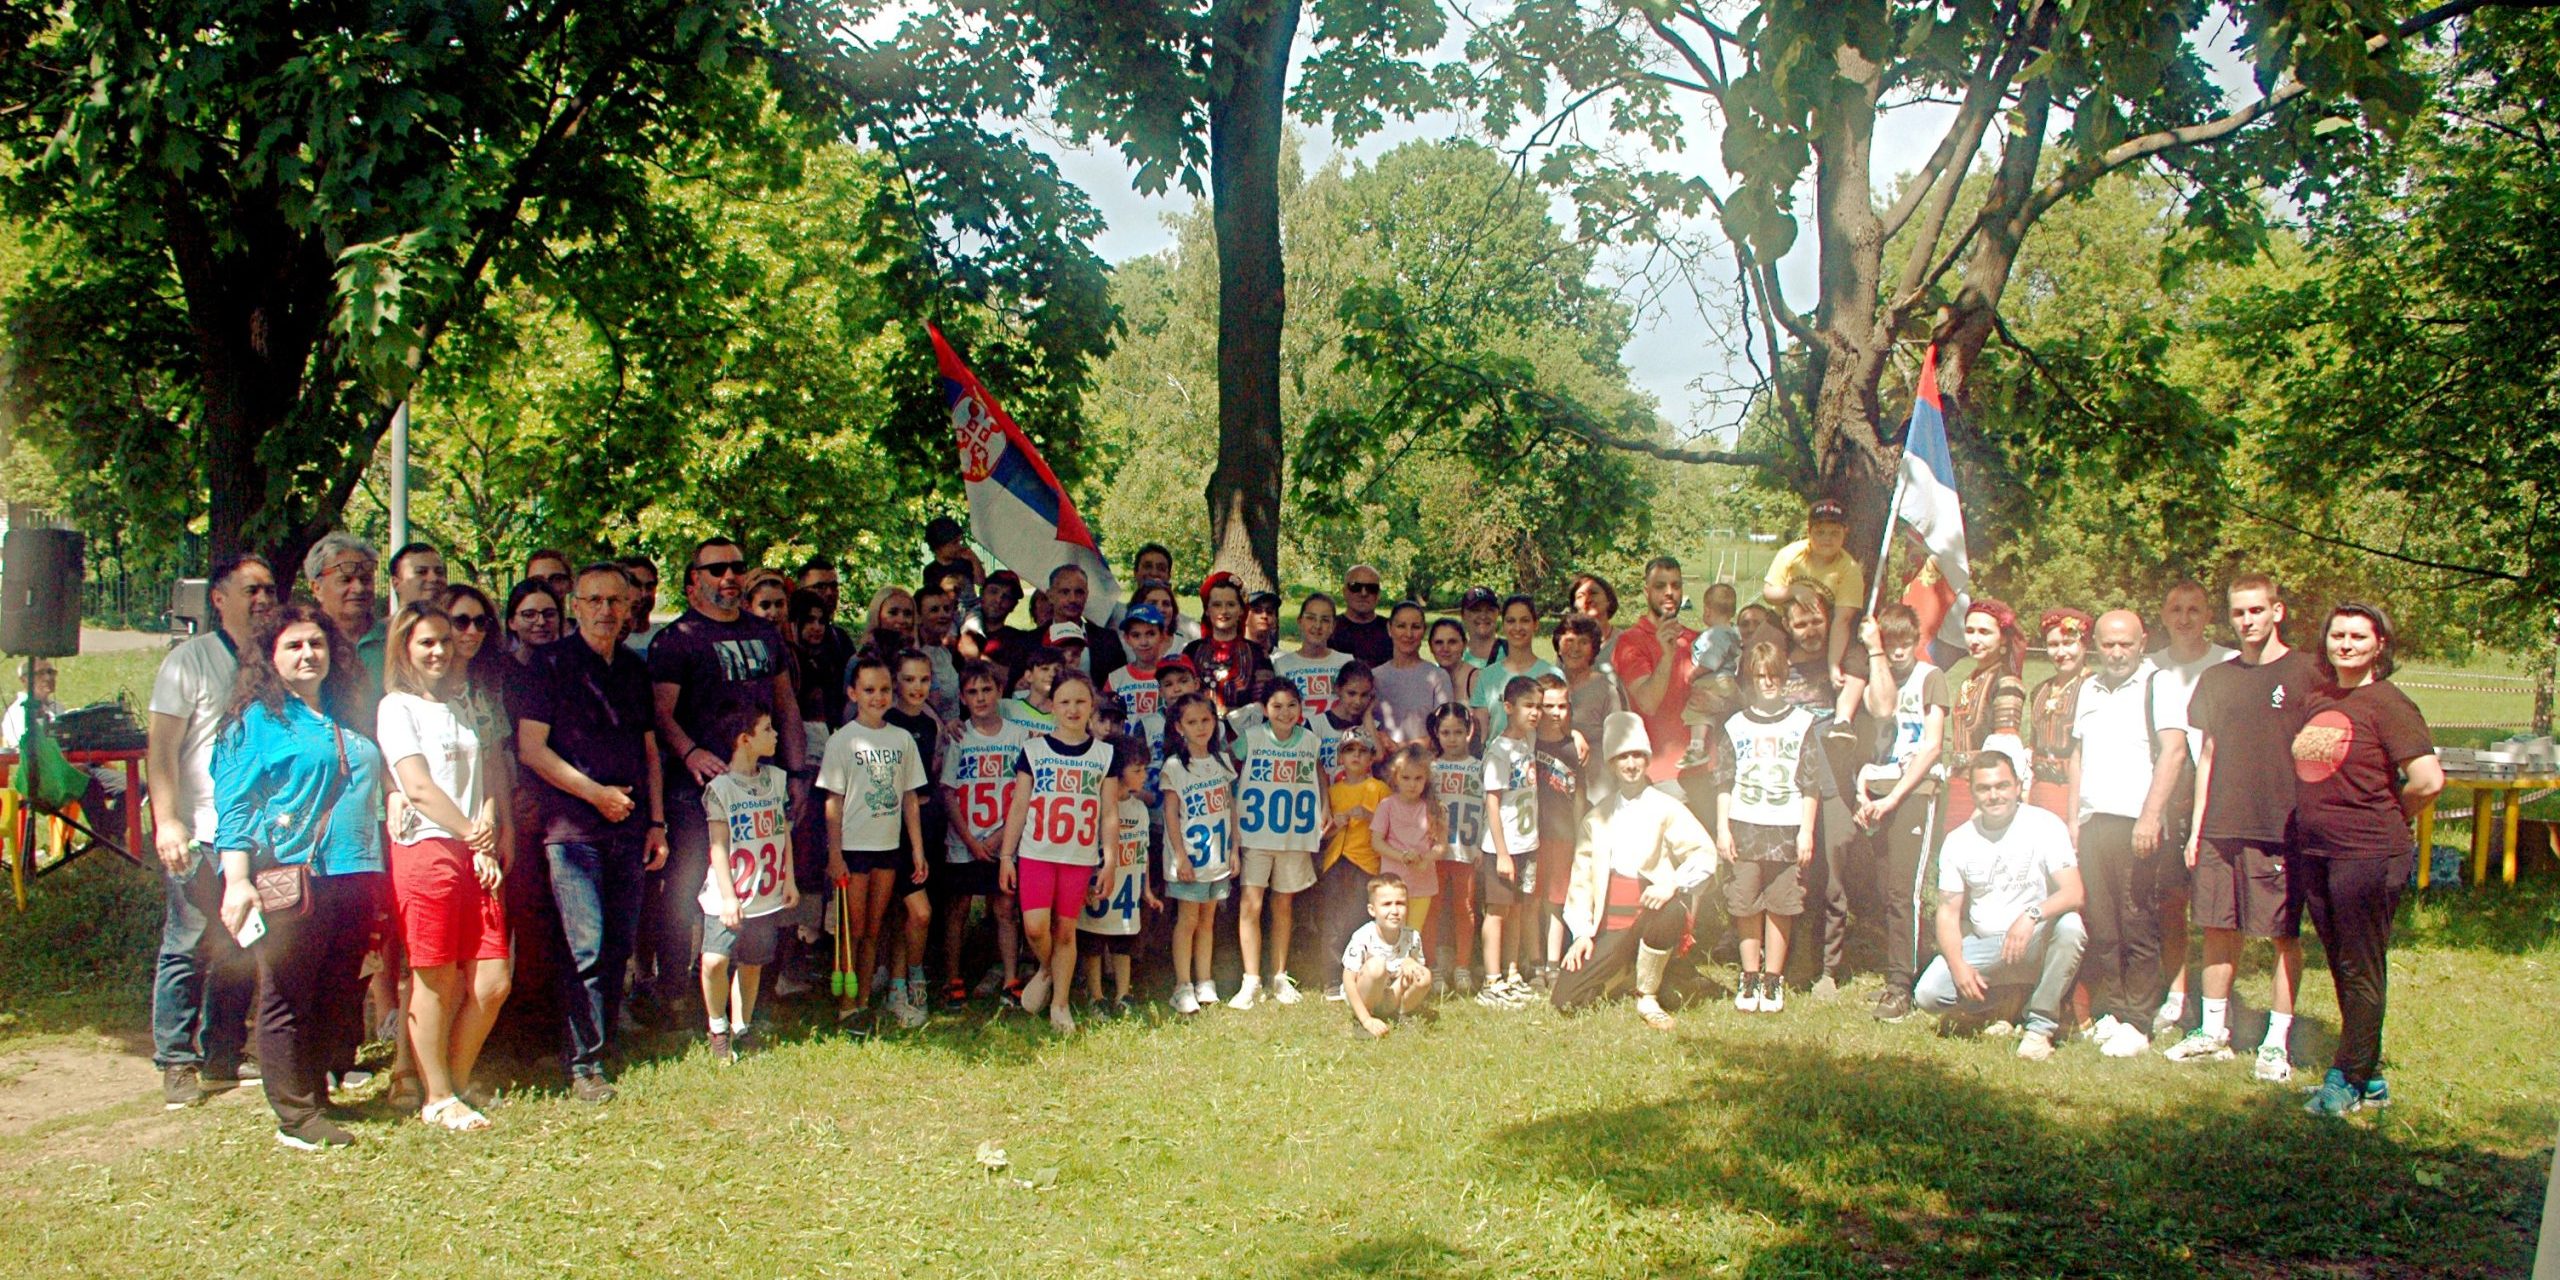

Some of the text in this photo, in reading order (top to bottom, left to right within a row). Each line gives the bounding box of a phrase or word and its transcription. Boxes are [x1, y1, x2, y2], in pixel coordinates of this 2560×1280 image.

[1029, 796, 1098, 846] 163
[1240, 788, 1316, 834] 309
[1186, 819, 1232, 868] 31
